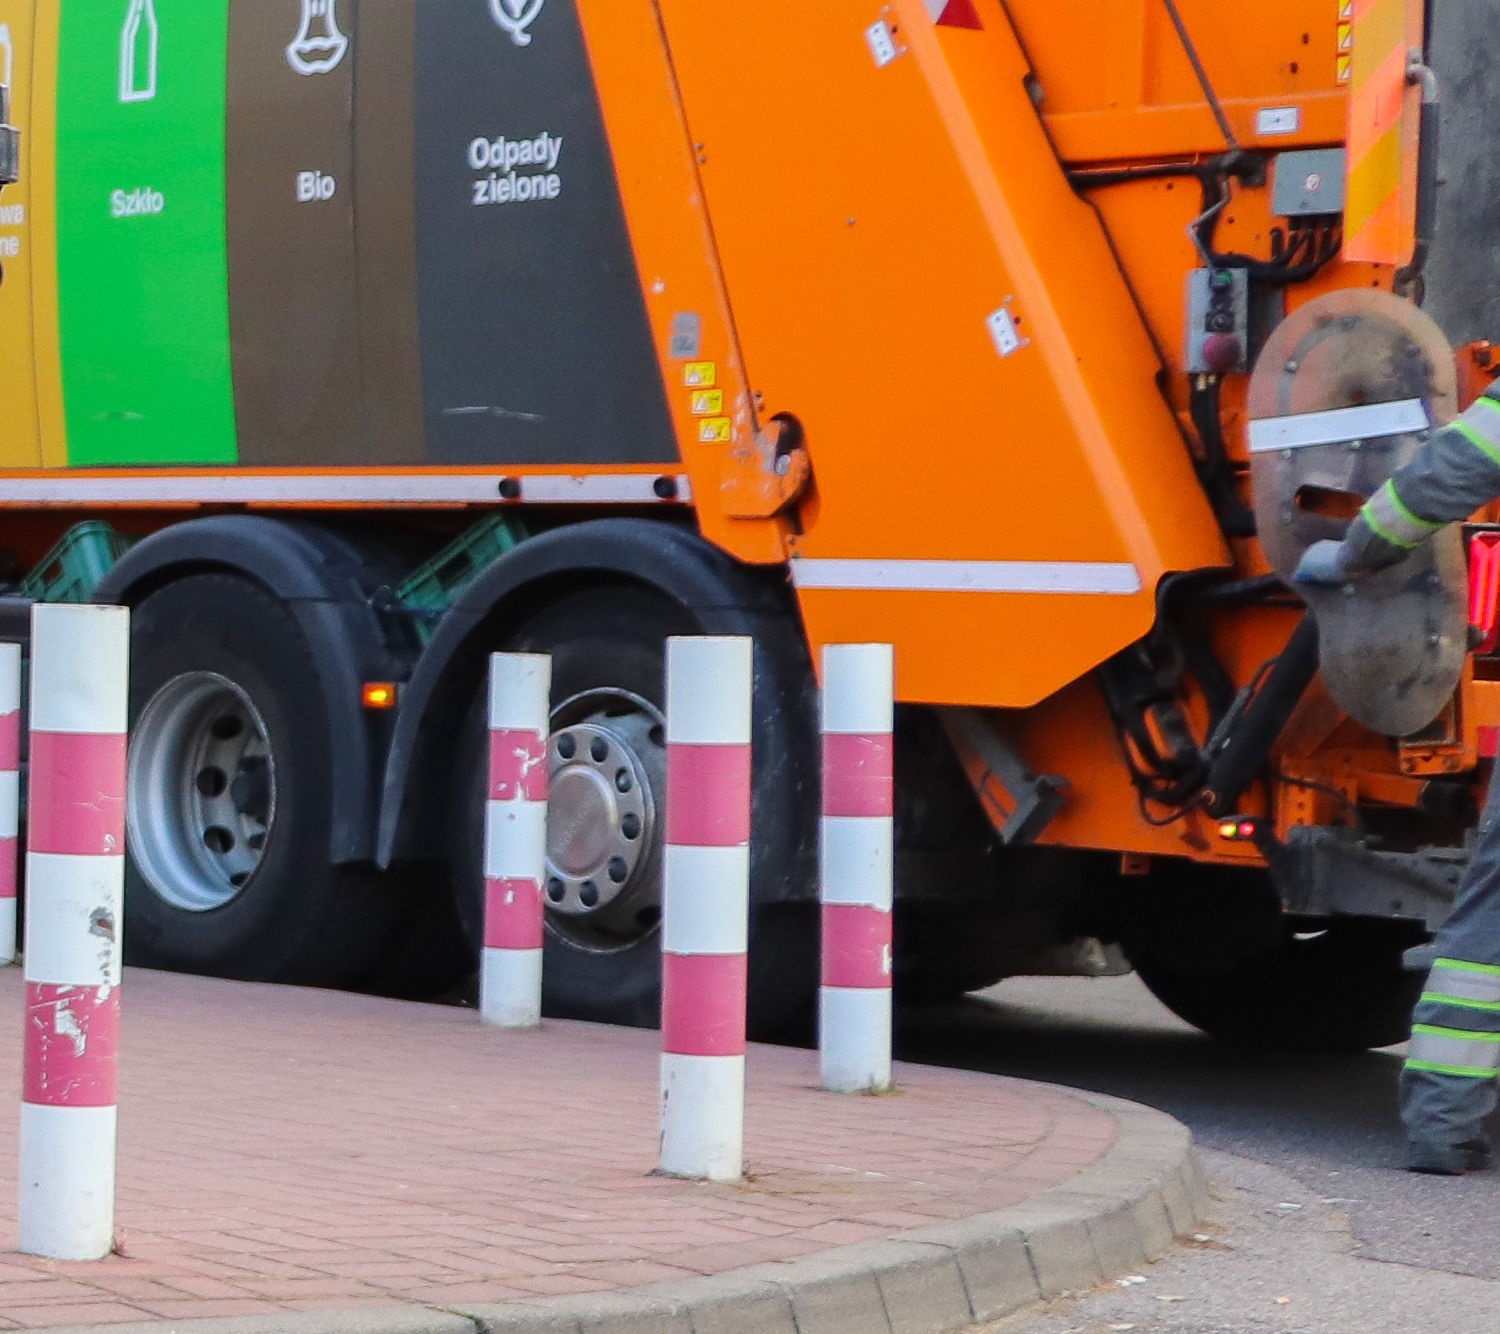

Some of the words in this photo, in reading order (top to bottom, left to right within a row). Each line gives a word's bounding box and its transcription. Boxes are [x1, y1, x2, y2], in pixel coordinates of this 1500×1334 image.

[469, 131, 563, 173] Odpady
[111, 187, 165, 217] Szkło
[296, 170, 336, 202] Bio
[473, 170, 561, 206] zielone
